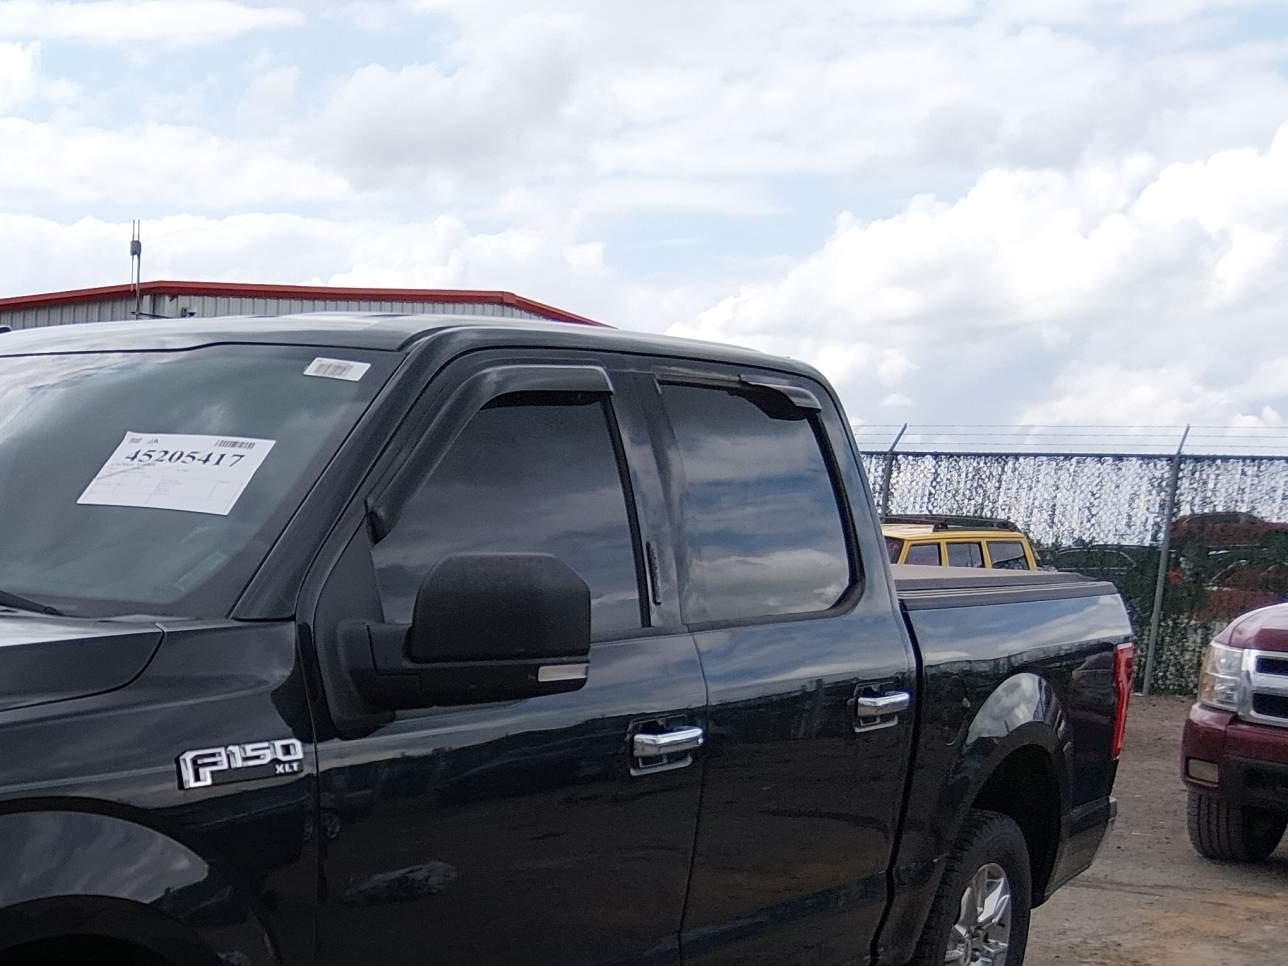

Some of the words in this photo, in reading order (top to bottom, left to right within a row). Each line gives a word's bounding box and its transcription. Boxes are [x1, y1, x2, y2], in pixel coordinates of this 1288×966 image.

[125, 448, 246, 467] 45205417
[179, 738, 304, 789] F150
[275, 761, 300, 774] XLT
